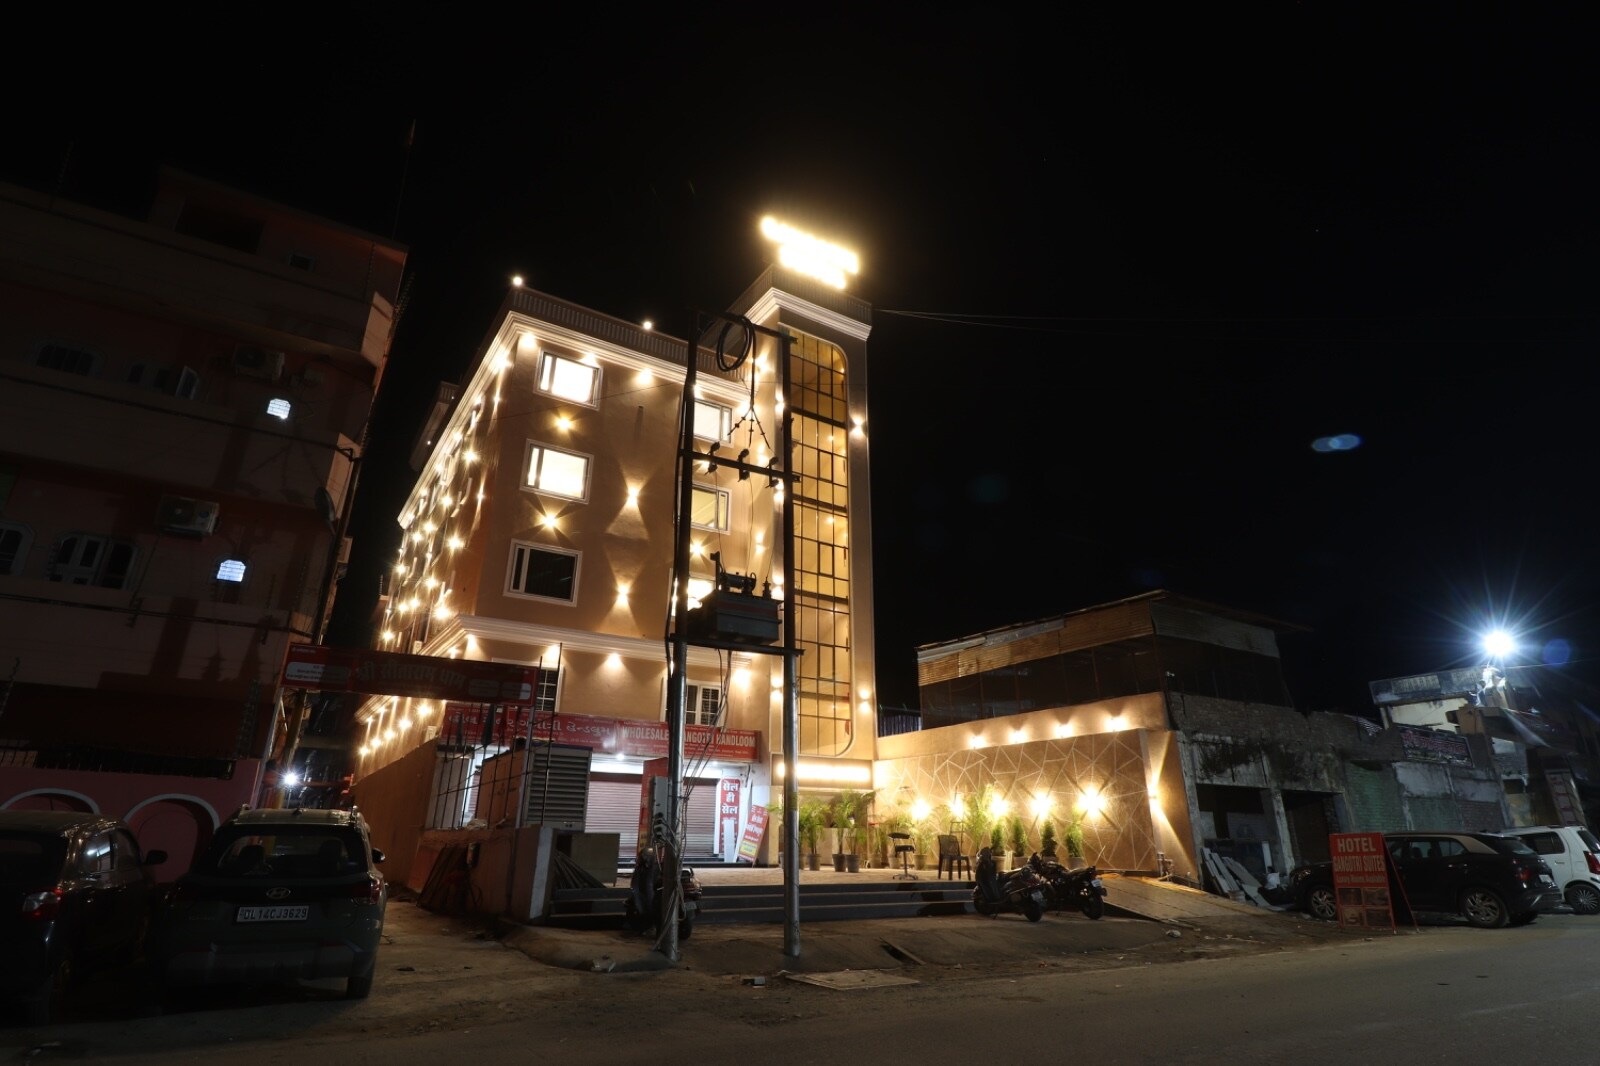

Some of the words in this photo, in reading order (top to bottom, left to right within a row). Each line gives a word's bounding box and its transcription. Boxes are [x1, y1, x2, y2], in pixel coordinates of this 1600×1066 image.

[622, 726, 669, 741] WHOLESALE
[683, 730, 715, 744] ANGOTRI
[716, 733, 756, 747] HANDLOOM
[1337, 837, 1376, 853] HOTEL
